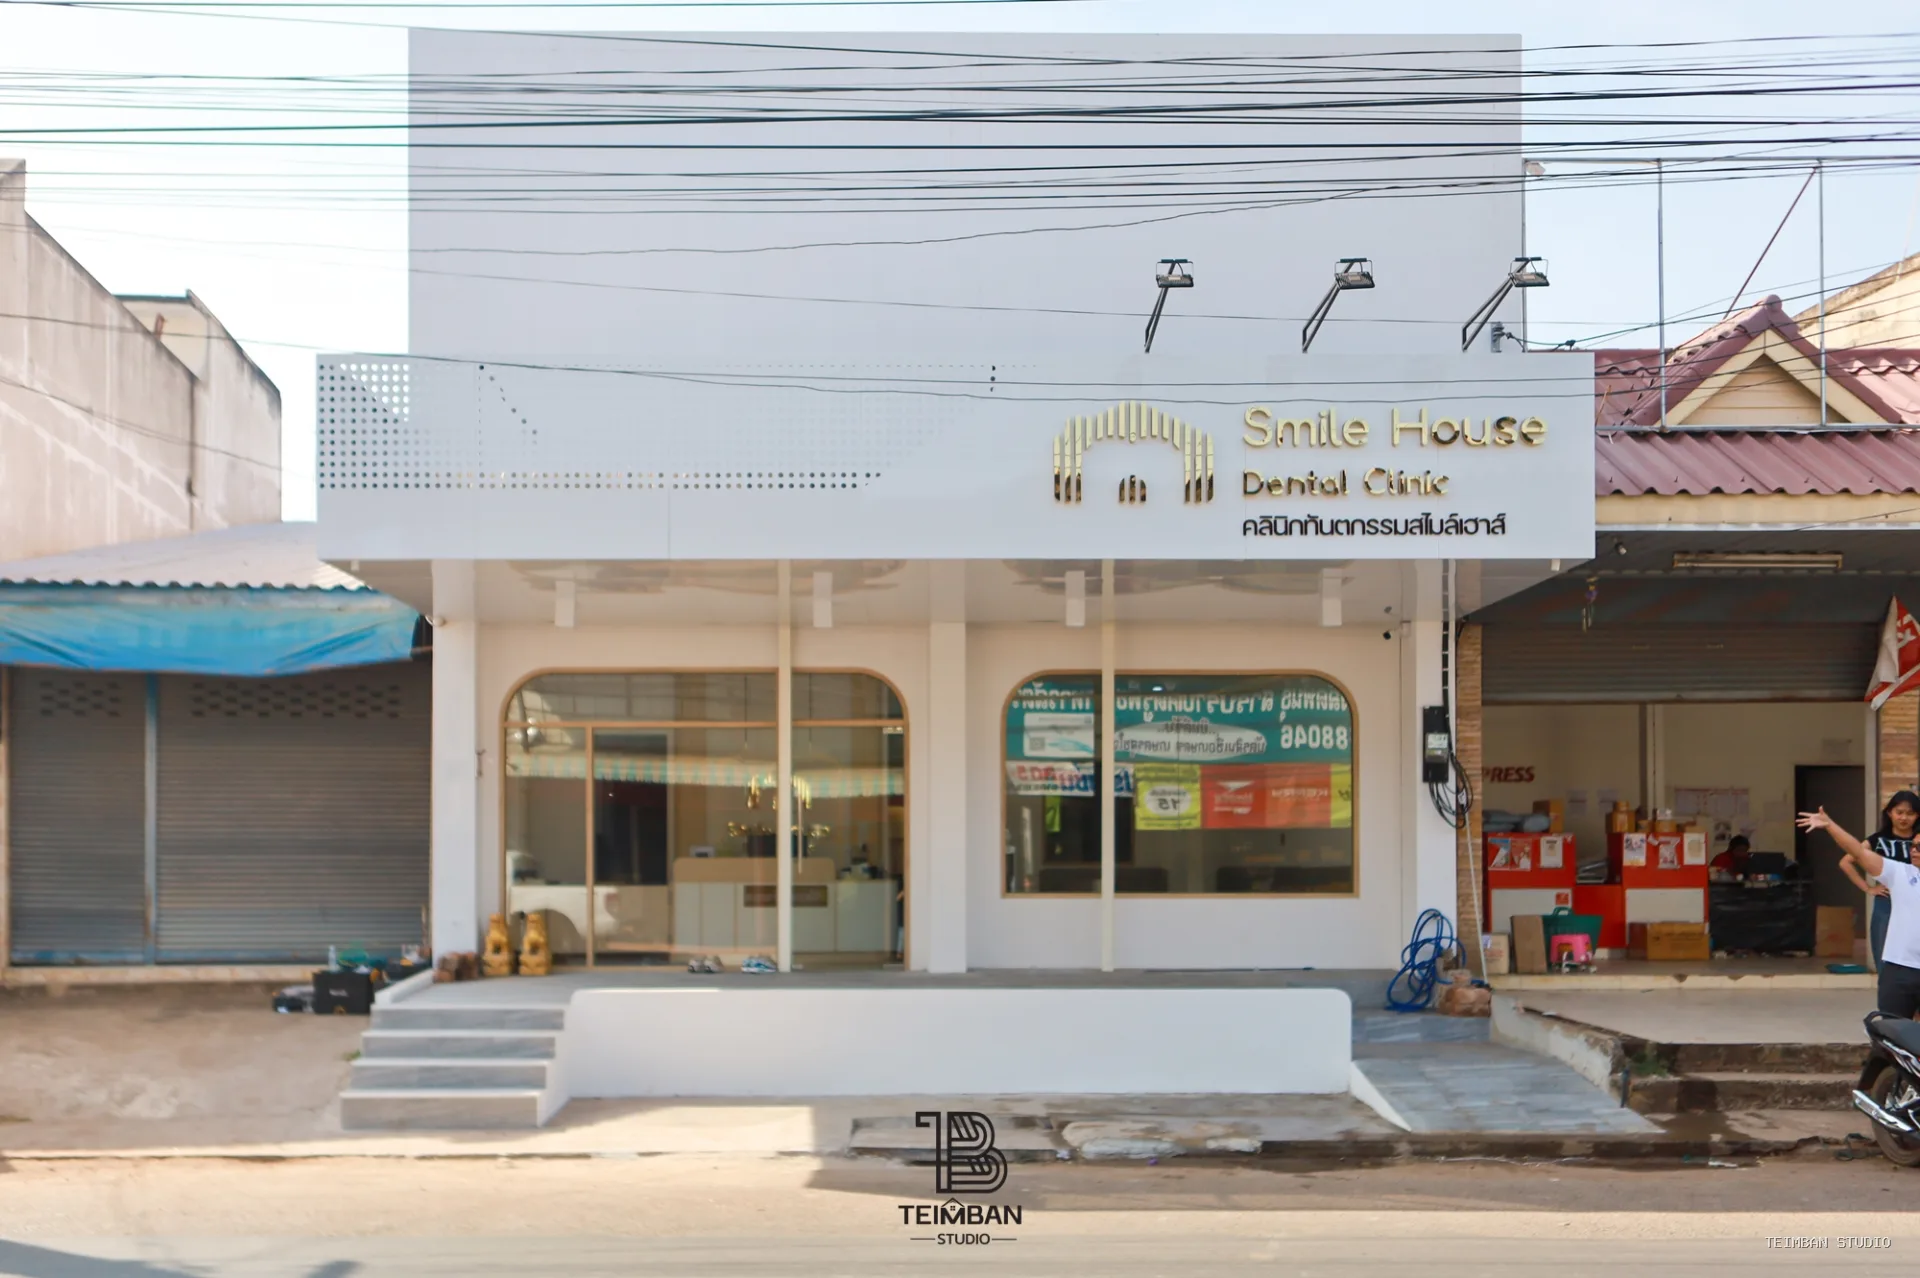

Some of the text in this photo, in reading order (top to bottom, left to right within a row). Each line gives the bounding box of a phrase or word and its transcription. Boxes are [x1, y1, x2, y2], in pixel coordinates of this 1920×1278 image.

[1243, 405, 1549, 448] Smile House
[1242, 466, 1450, 497] Dental Clinic
[1242, 512, 1507, 537] คลินิกทันตกรรมสไมล์เฮาส์
